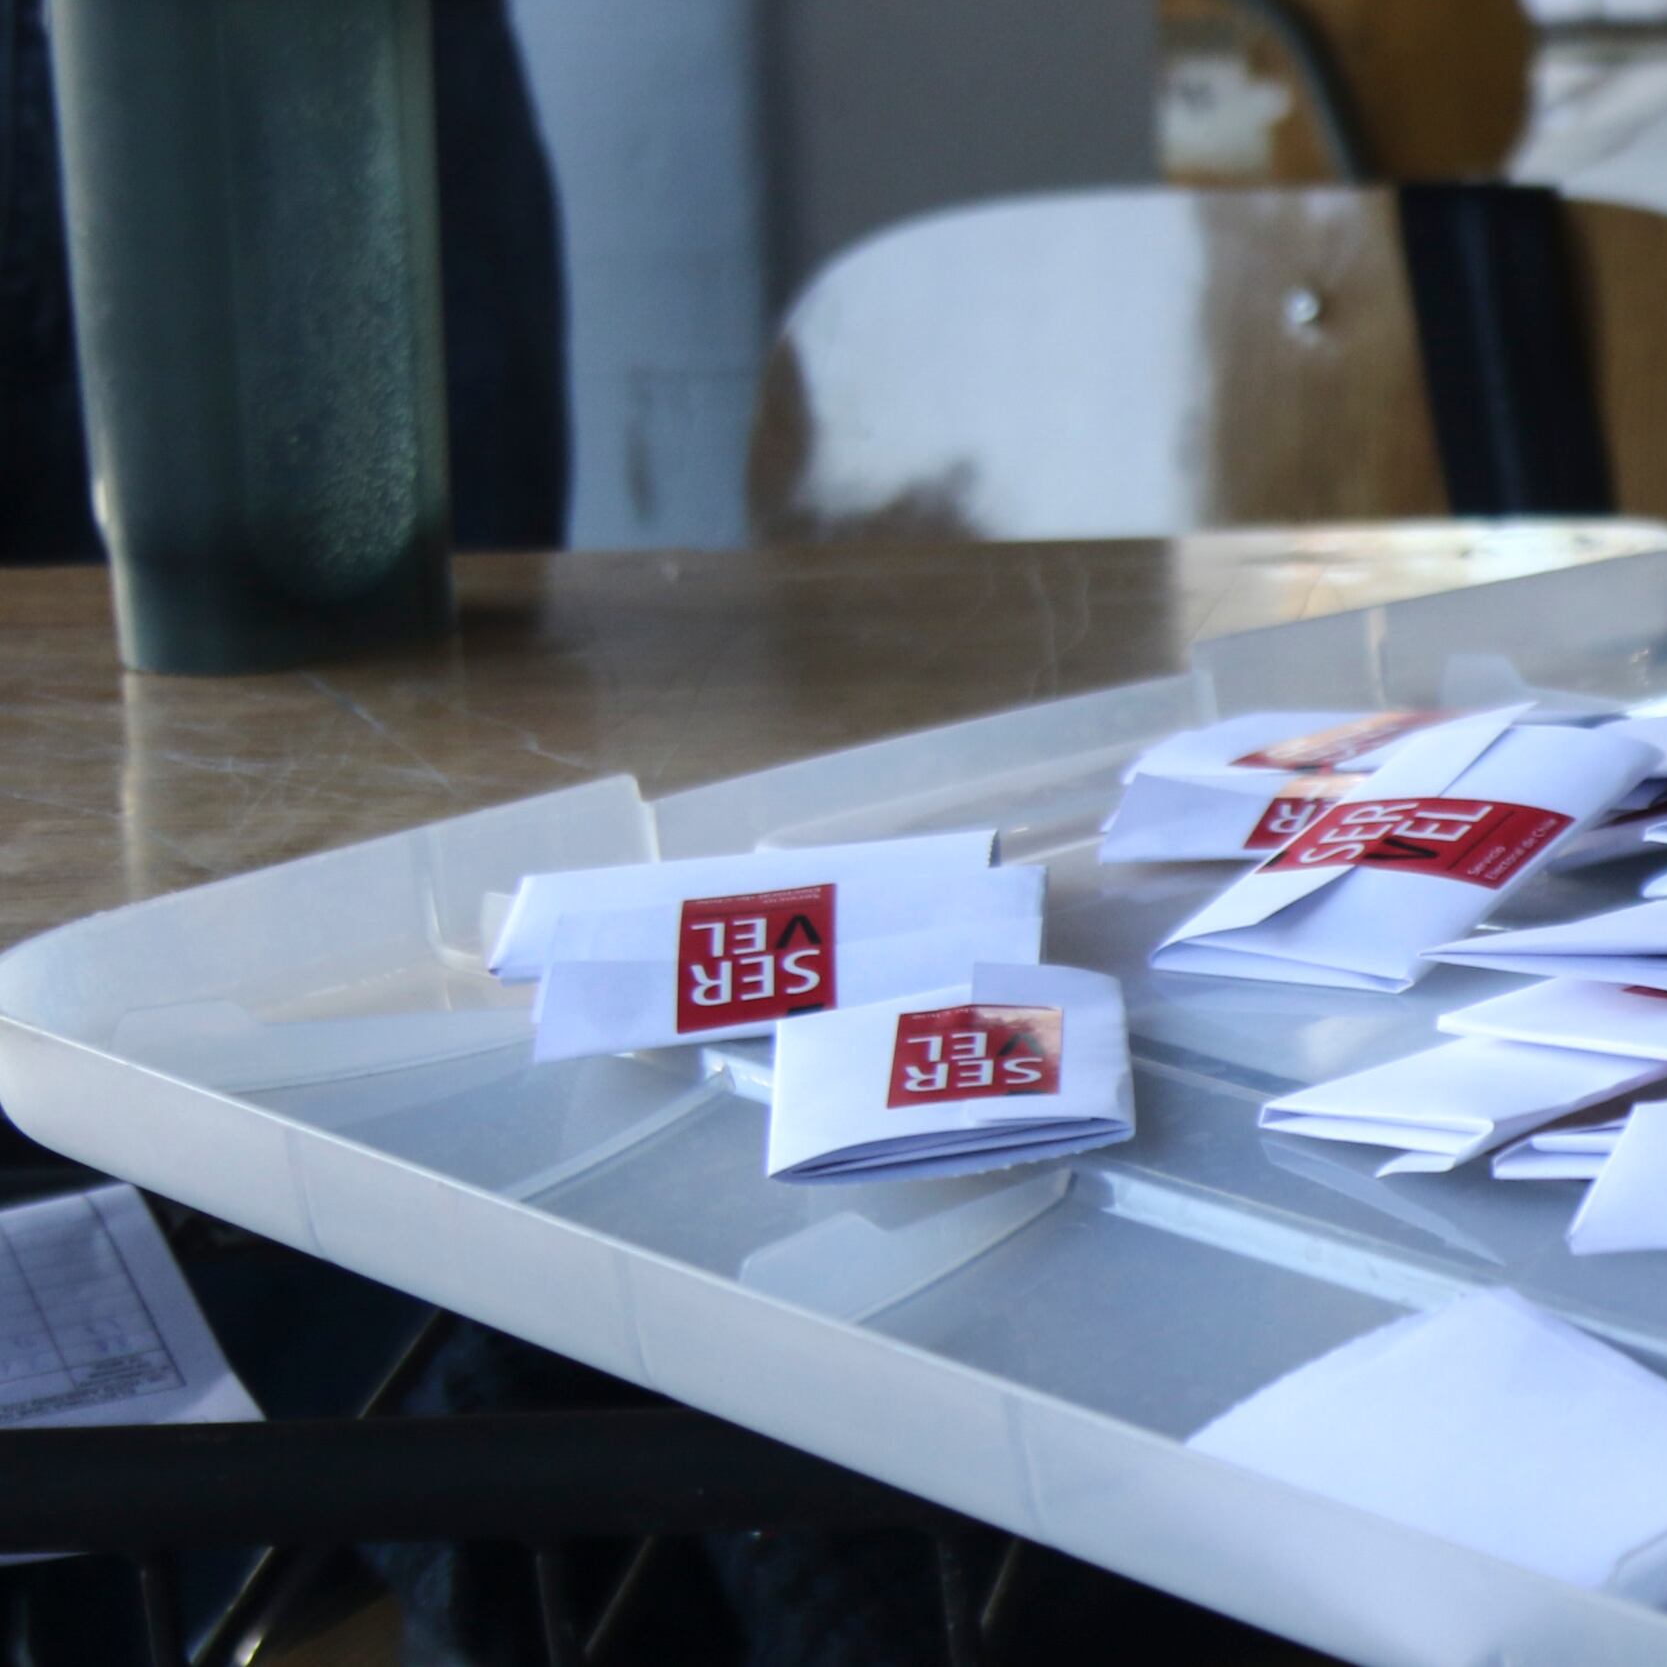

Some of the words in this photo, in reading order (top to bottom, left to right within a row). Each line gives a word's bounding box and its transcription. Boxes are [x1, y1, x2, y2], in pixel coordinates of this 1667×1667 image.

[1300, 801, 1419, 865] SER
[1363, 804, 1494, 861] VEL
[690, 914, 821, 957] VEL
[690, 949, 822, 1007] SER
[907, 1031, 1046, 1063] VEL
[904, 1057, 1044, 1093] SER
